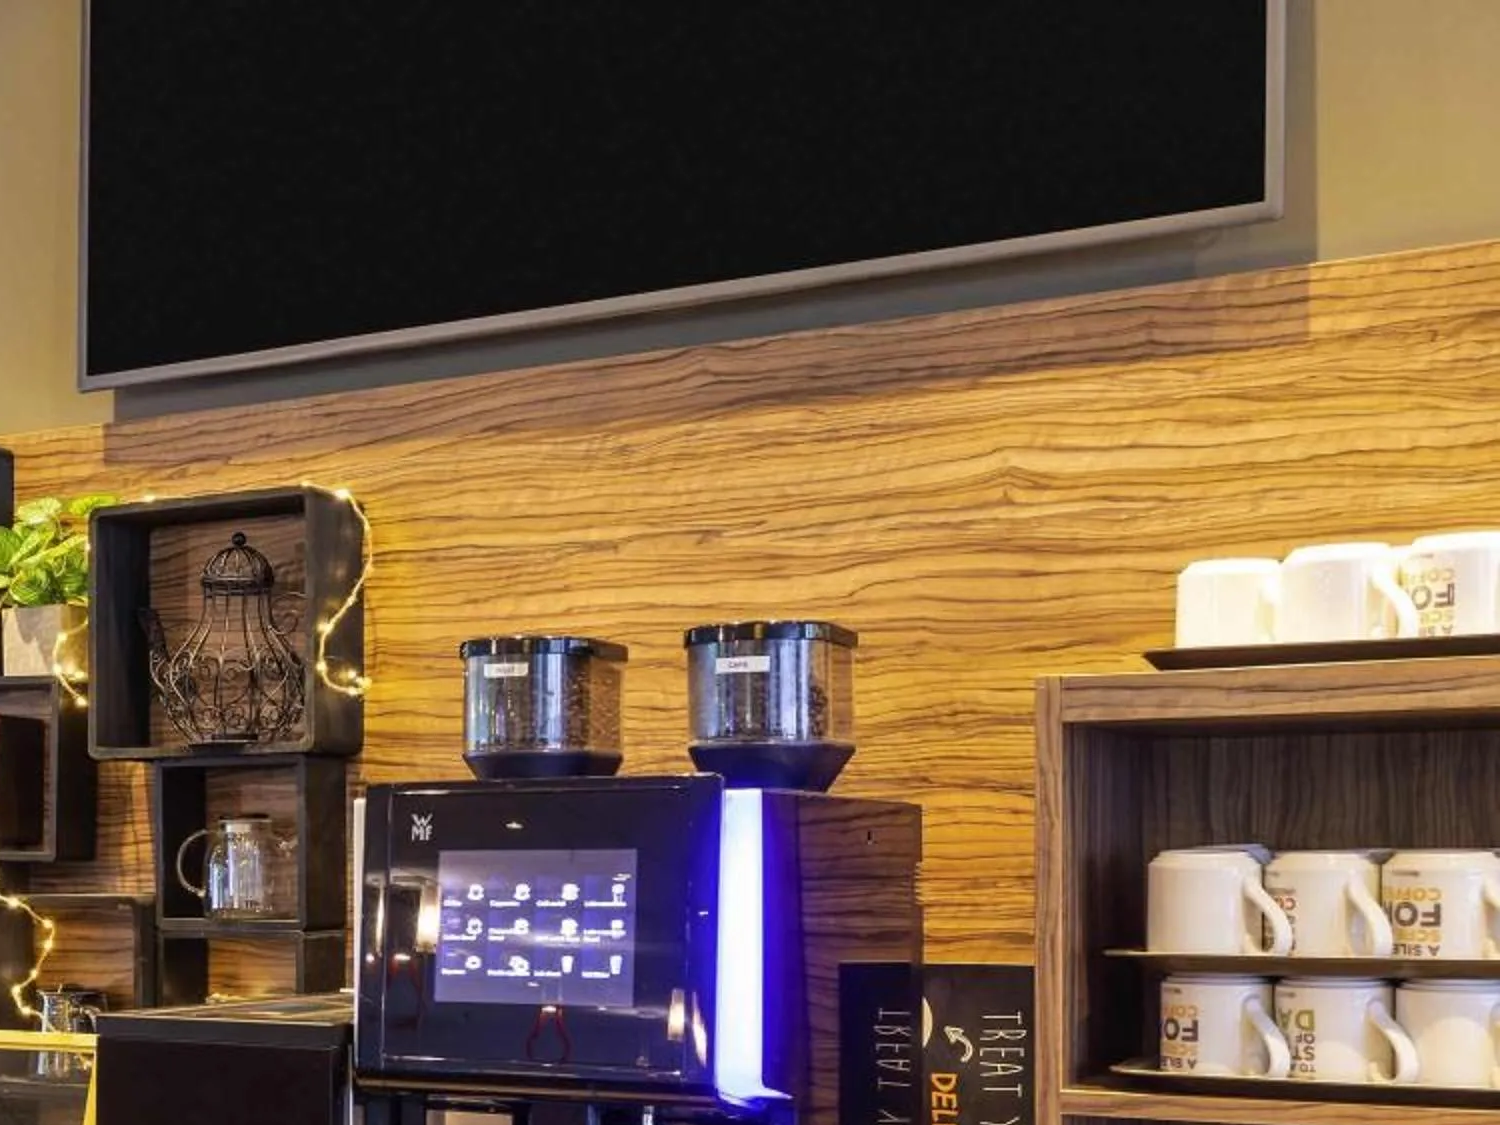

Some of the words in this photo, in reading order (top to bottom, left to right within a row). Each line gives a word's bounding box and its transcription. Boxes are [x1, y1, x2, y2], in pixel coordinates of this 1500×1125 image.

[1409, 584, 1455, 611] FO
[411, 812, 433, 841] WMF
[1162, 1018, 1199, 1042] FO
[979, 1010, 1028, 1098] TREAT
